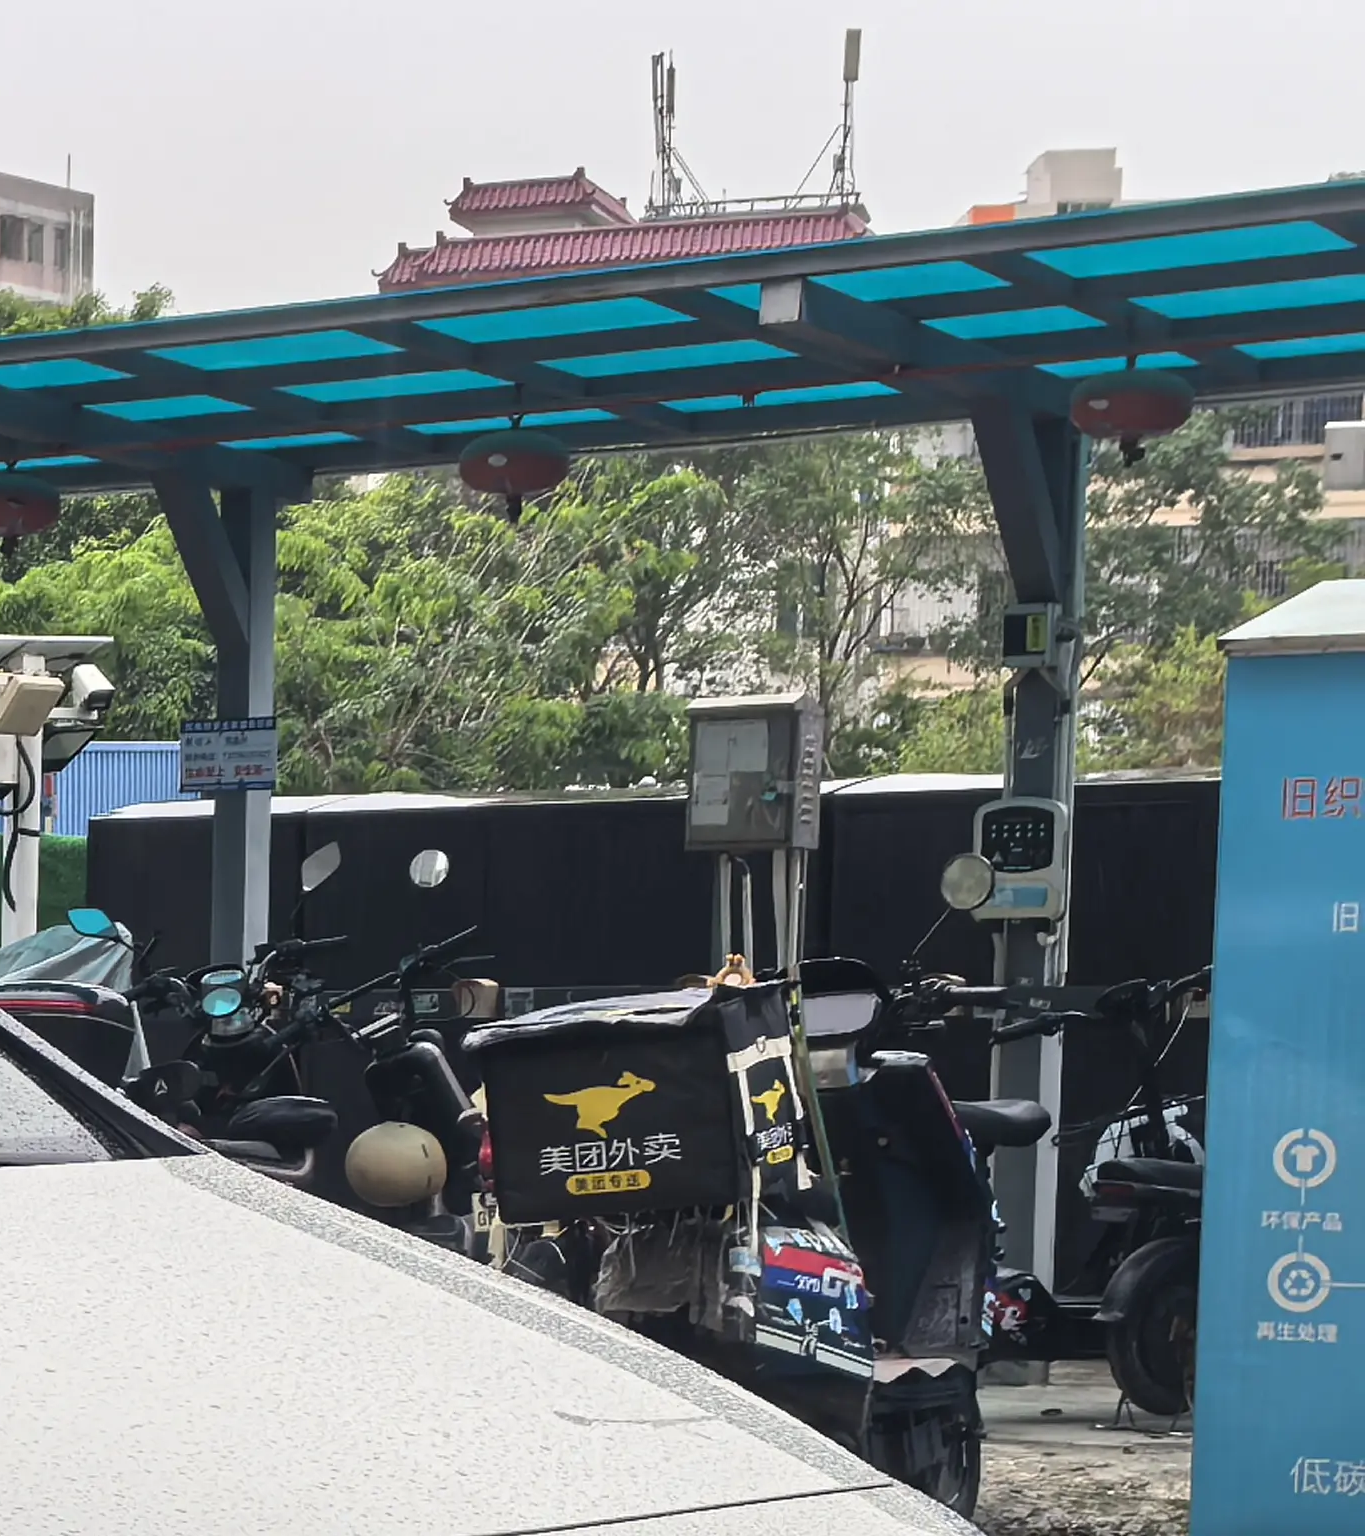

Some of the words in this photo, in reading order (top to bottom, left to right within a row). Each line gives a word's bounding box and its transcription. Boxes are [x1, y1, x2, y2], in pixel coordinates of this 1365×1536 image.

[1331, 900, 1360, 933] 旧
[539, 1132, 683, 1175] 美团外卖
[1260, 1210, 1343, 1232] 环保产品
[1256, 1321, 1338, 1343] 再生处理
[1289, 1456, 1365, 1496] 低碳
